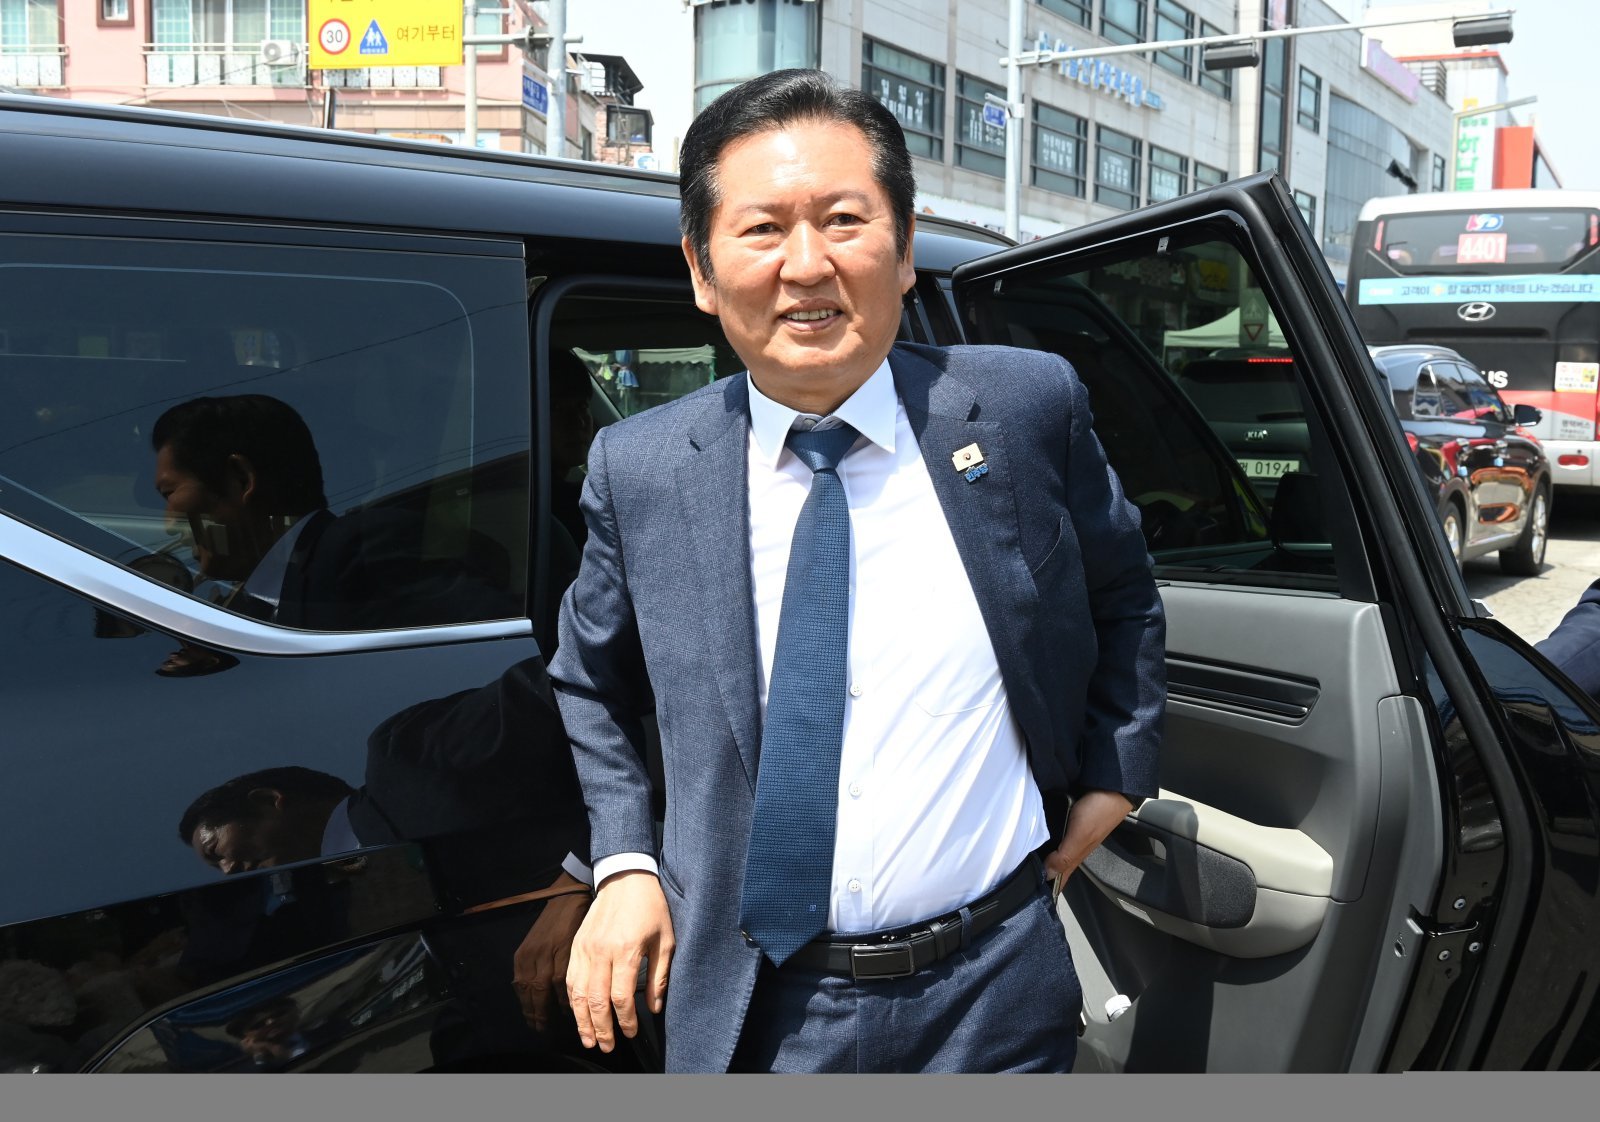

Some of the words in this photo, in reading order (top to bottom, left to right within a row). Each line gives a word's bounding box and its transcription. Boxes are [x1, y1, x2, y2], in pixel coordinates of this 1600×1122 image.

[326, 29, 343, 44] 30
[396, 24, 456, 42] 여기부터
[1460, 236, 1505, 261] 4401
[1401, 286, 1430, 296] 고객이
[1247, 431, 1264, 439] KIA
[1255, 461, 1290, 476] 0194
